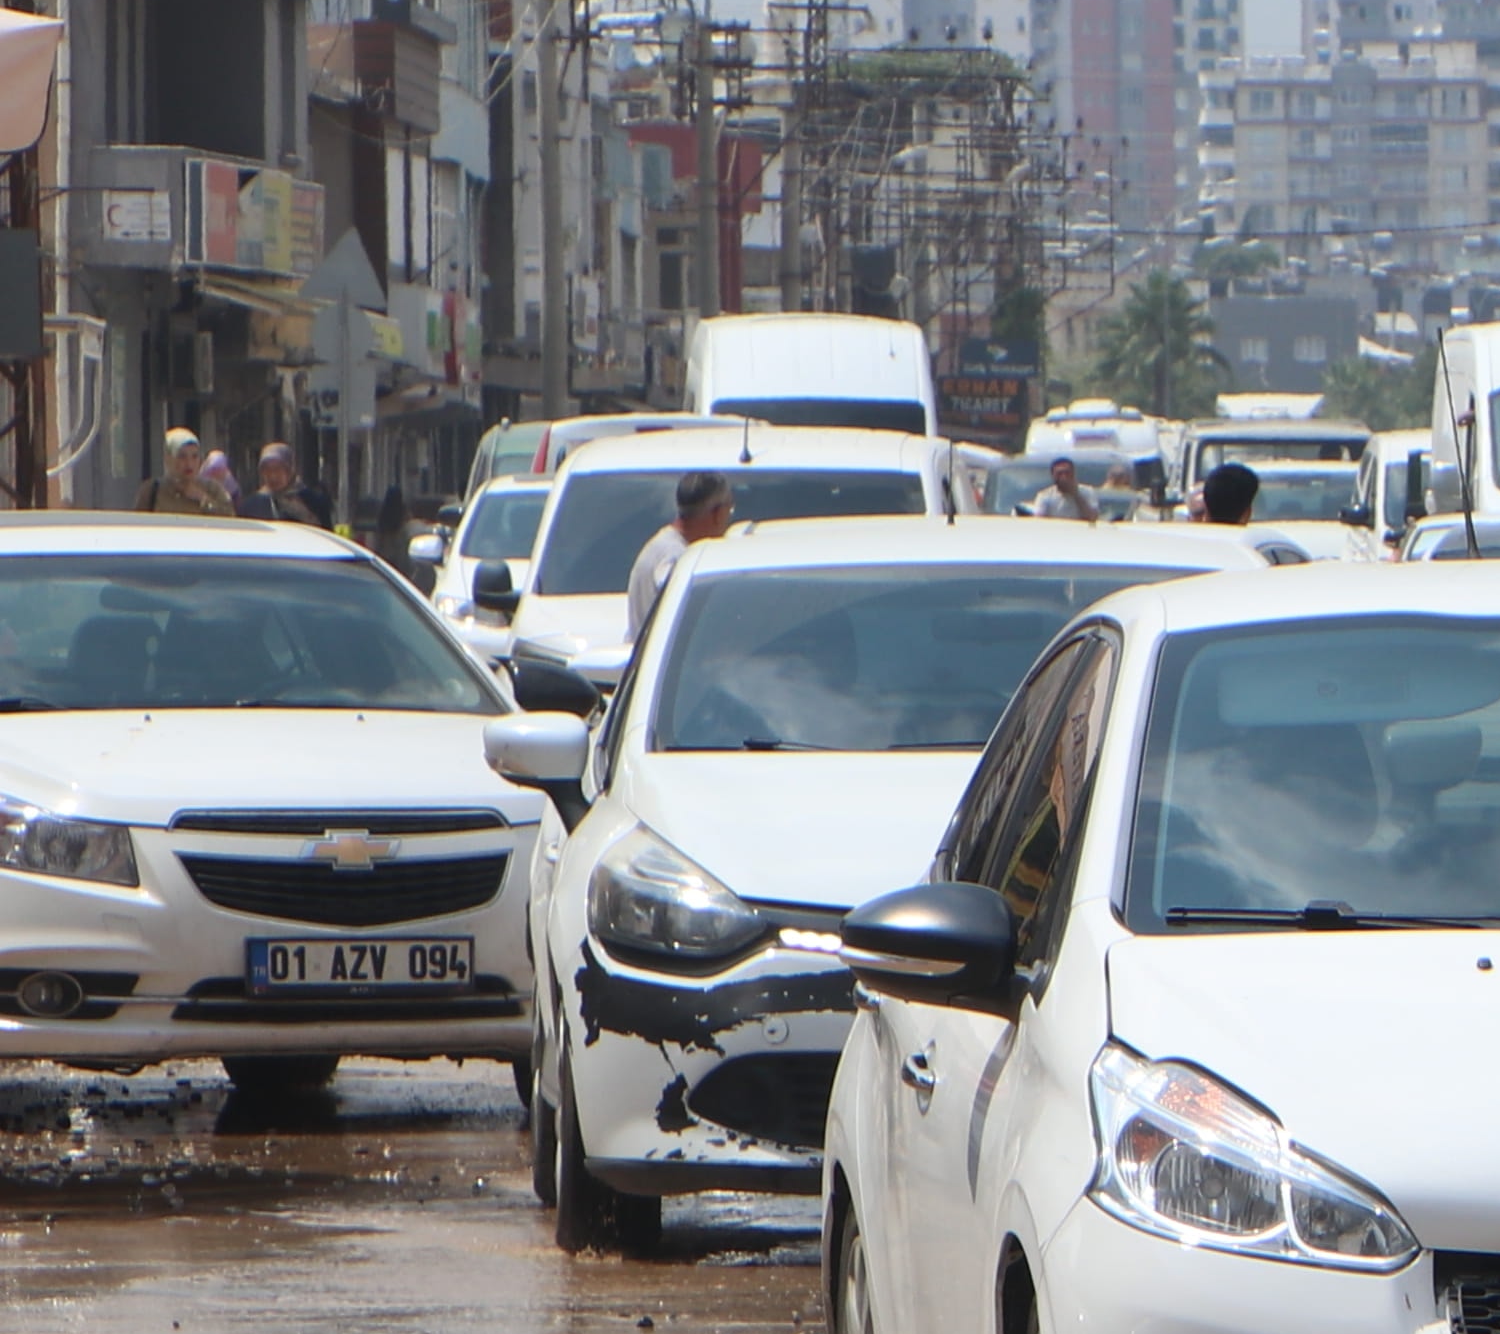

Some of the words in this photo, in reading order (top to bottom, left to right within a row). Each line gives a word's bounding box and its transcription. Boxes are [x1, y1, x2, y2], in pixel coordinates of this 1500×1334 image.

[270, 945, 306, 981] 01
[331, 945, 387, 981] AZV
[409, 945, 467, 980] 094
